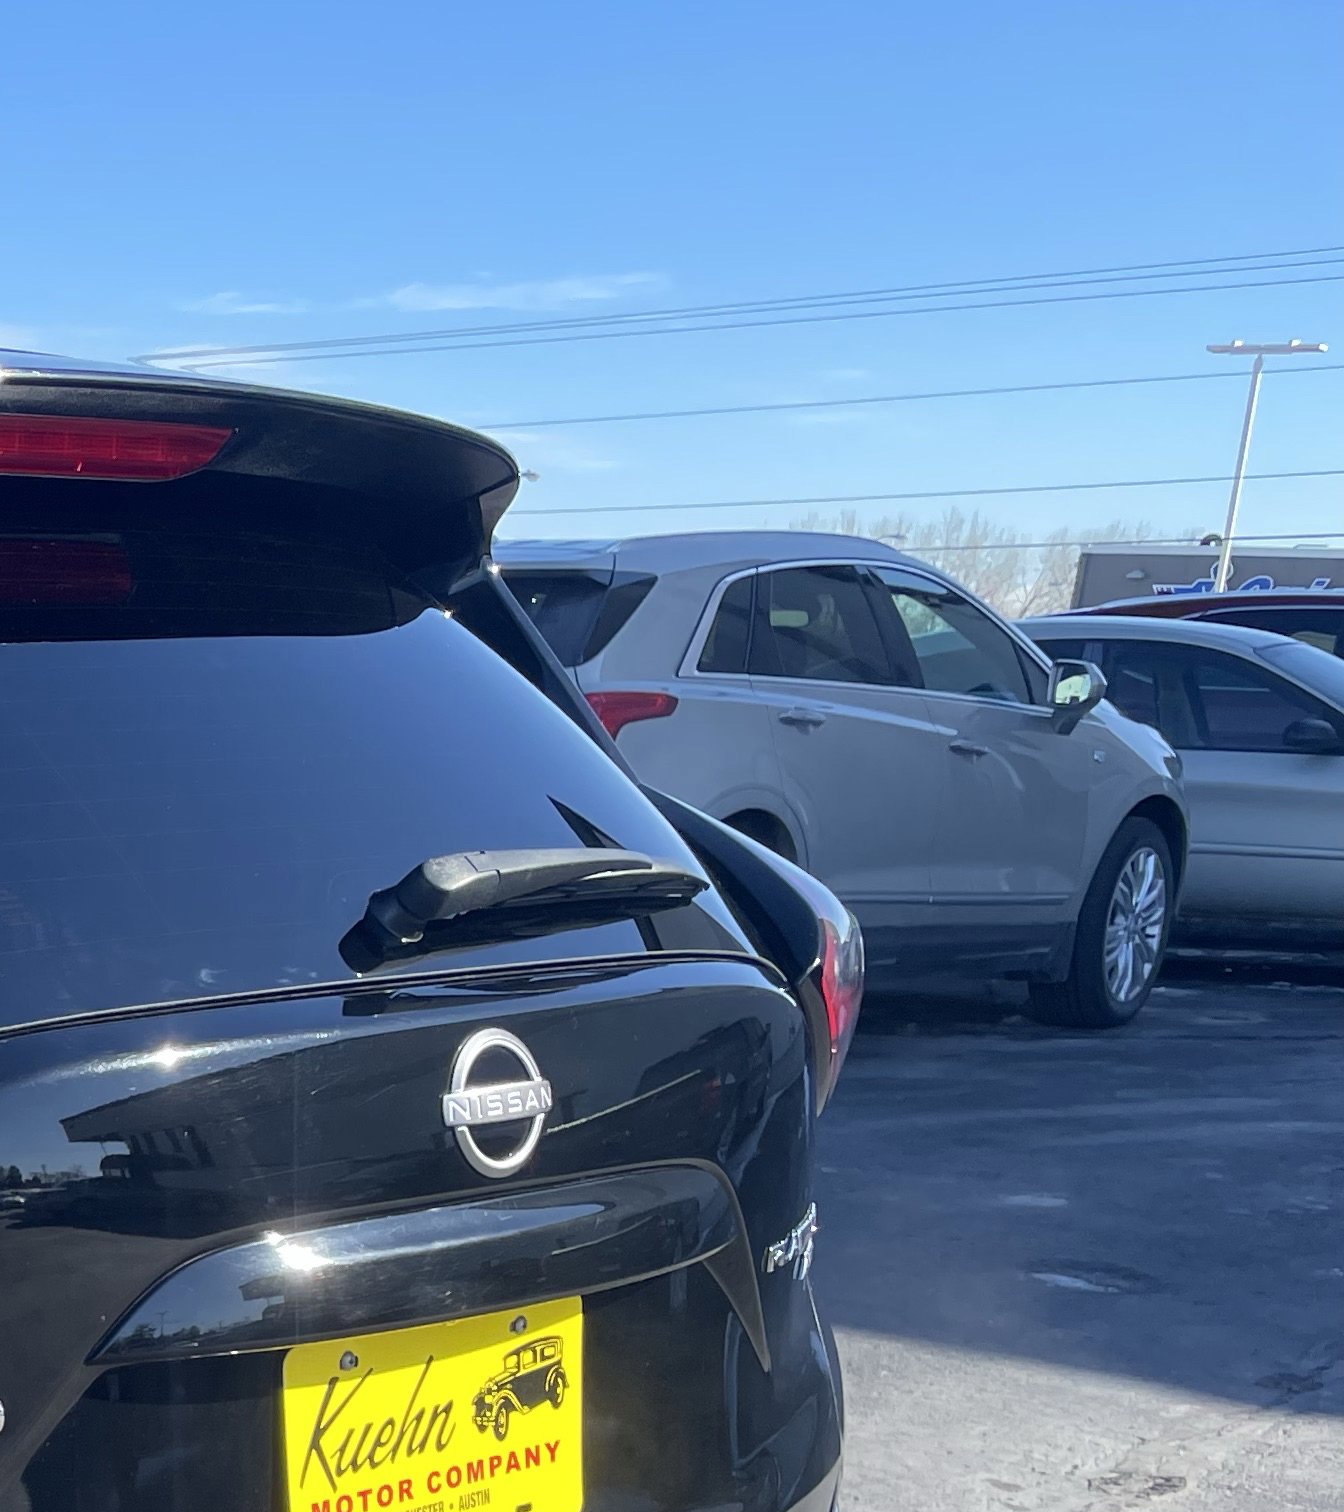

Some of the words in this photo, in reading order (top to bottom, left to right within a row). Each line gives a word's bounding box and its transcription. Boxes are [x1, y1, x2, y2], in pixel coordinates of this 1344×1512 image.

[448, 1086, 552, 1122] NISSAN
[298, 1355, 457, 1493] Kuehn
[426, 1439, 561, 1495] COMPANY
[458, 1488, 491, 1512] AUSTIN
